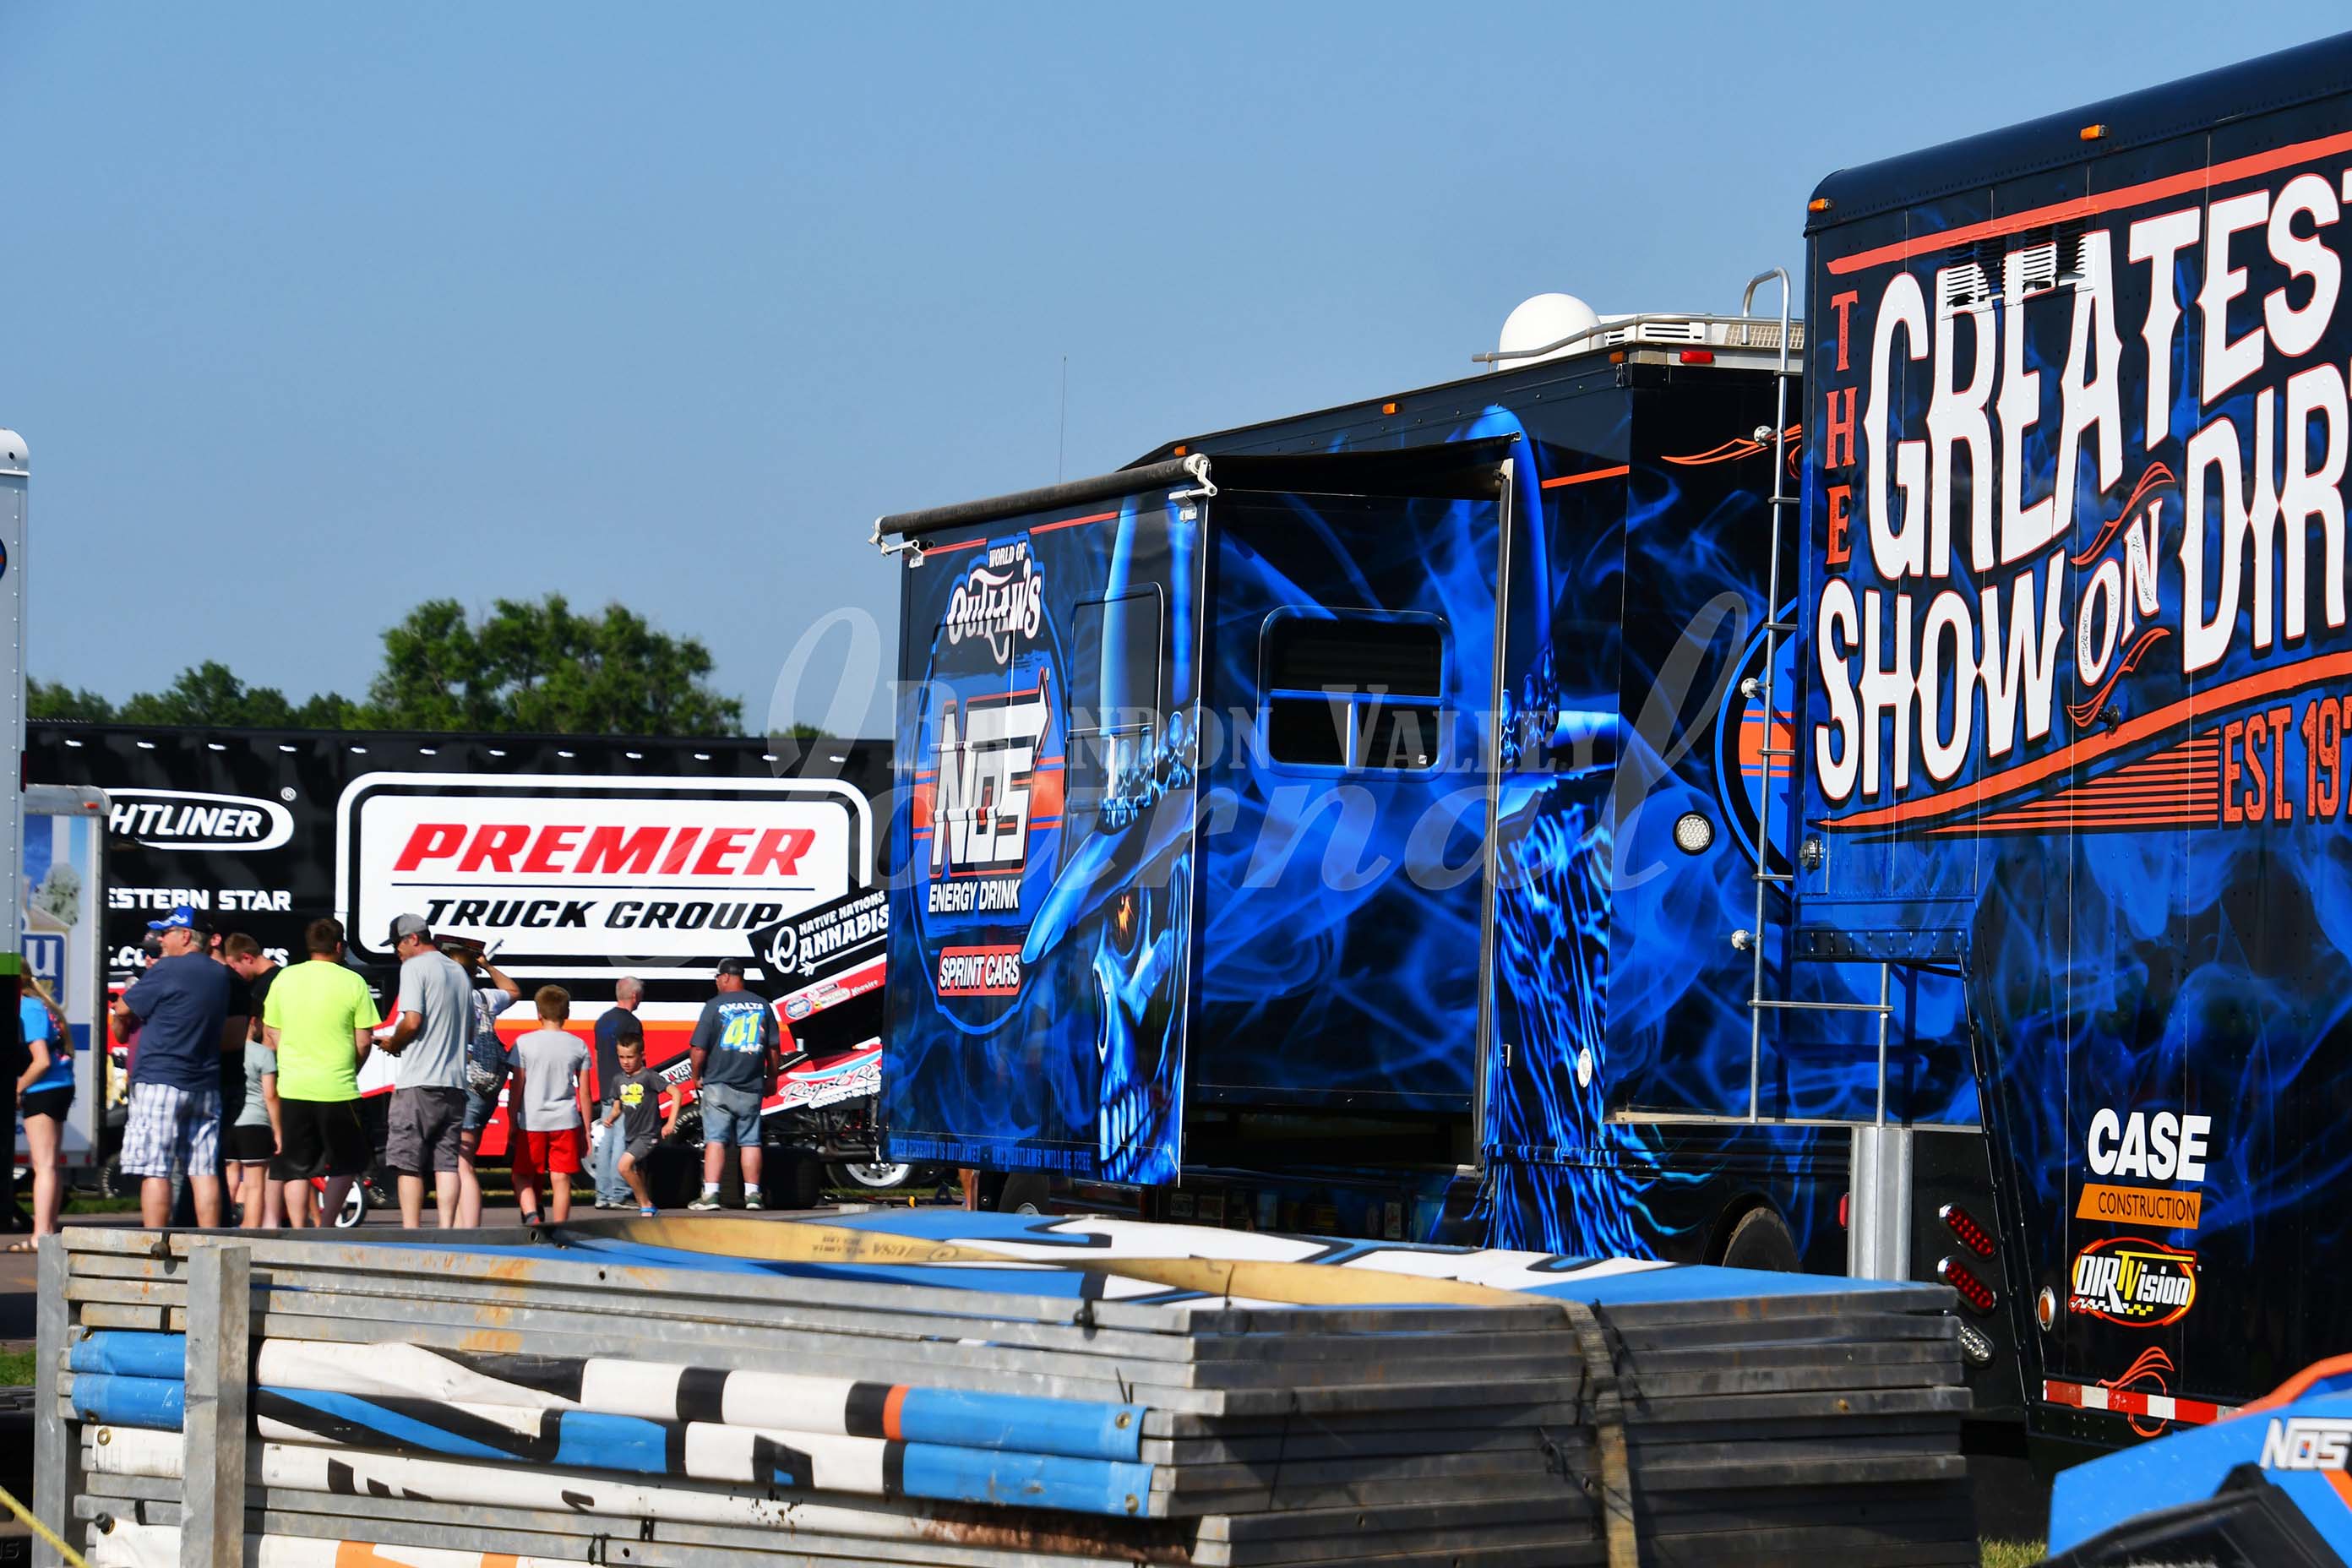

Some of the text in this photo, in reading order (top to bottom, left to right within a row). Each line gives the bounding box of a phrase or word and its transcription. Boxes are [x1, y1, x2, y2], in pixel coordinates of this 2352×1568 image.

[1826, 290, 1859, 565] THE
[989, 541, 1028, 569] WORLD OF
[1816, 357, 2352, 800] SHOW ON DIR
[932, 681, 1049, 866] NOS
[2224, 706, 2291, 822] EST.
[393, 823, 816, 876] PREMIER
[218, 890, 291, 911] STAR
[425, 899, 784, 931] TRUCK GROUP
[798, 890, 886, 936] NATIVE NATIONS
[928, 879, 1020, 912] ENERGY DRINK
[939, 952, 1020, 988] SPRINT CARS
[722, 1012, 761, 1047] 41
[2088, 1108, 2212, 1182] CASE
[2098, 1191, 2197, 1222] CONSTRUCTION
[2259, 1418, 2352, 1470] NOS
